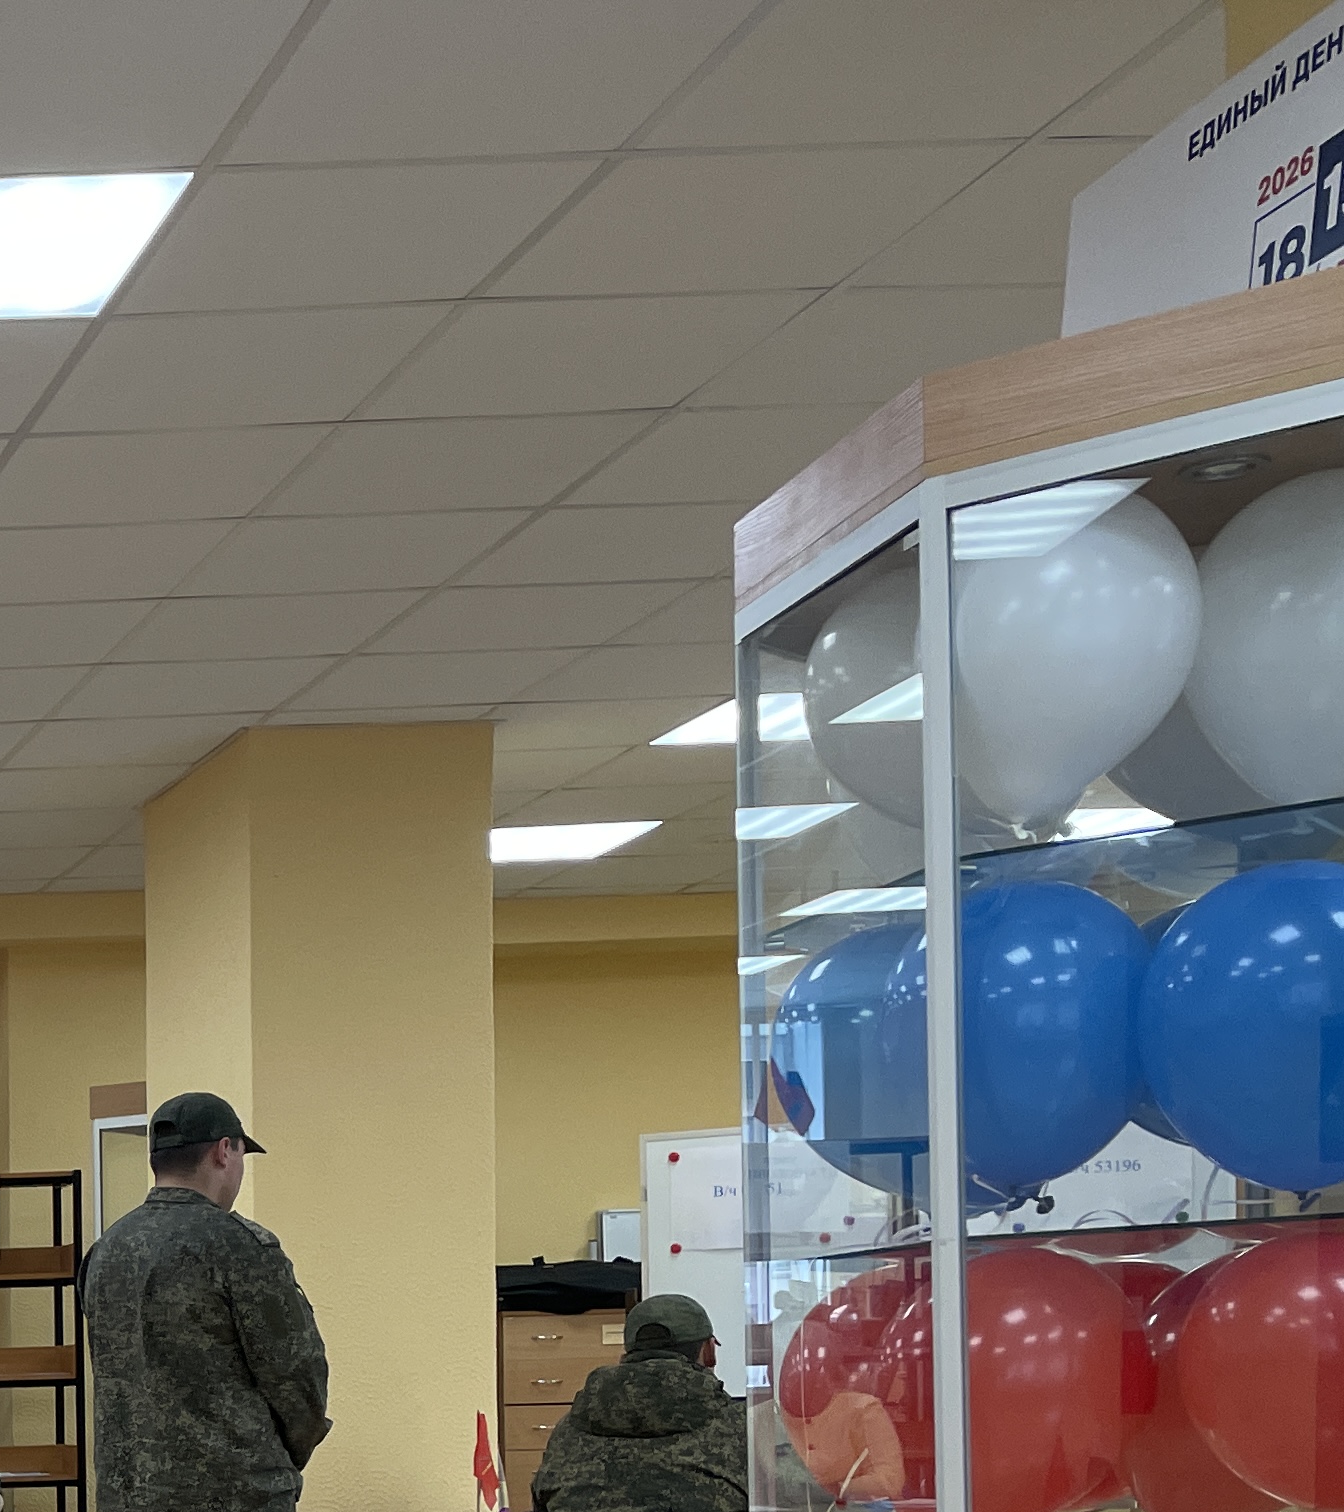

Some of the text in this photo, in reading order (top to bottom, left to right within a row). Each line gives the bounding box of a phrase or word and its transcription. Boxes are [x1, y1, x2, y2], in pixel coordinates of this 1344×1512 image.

[1187, 60, 1288, 162] ЕДИНЫЙ
[1257, 146, 1314, 207] 2026
[1258, 225, 1306, 286] 18
[713, 1185, 737, 1198] В/ч
[1094, 1160, 1142, 1173] 53196
